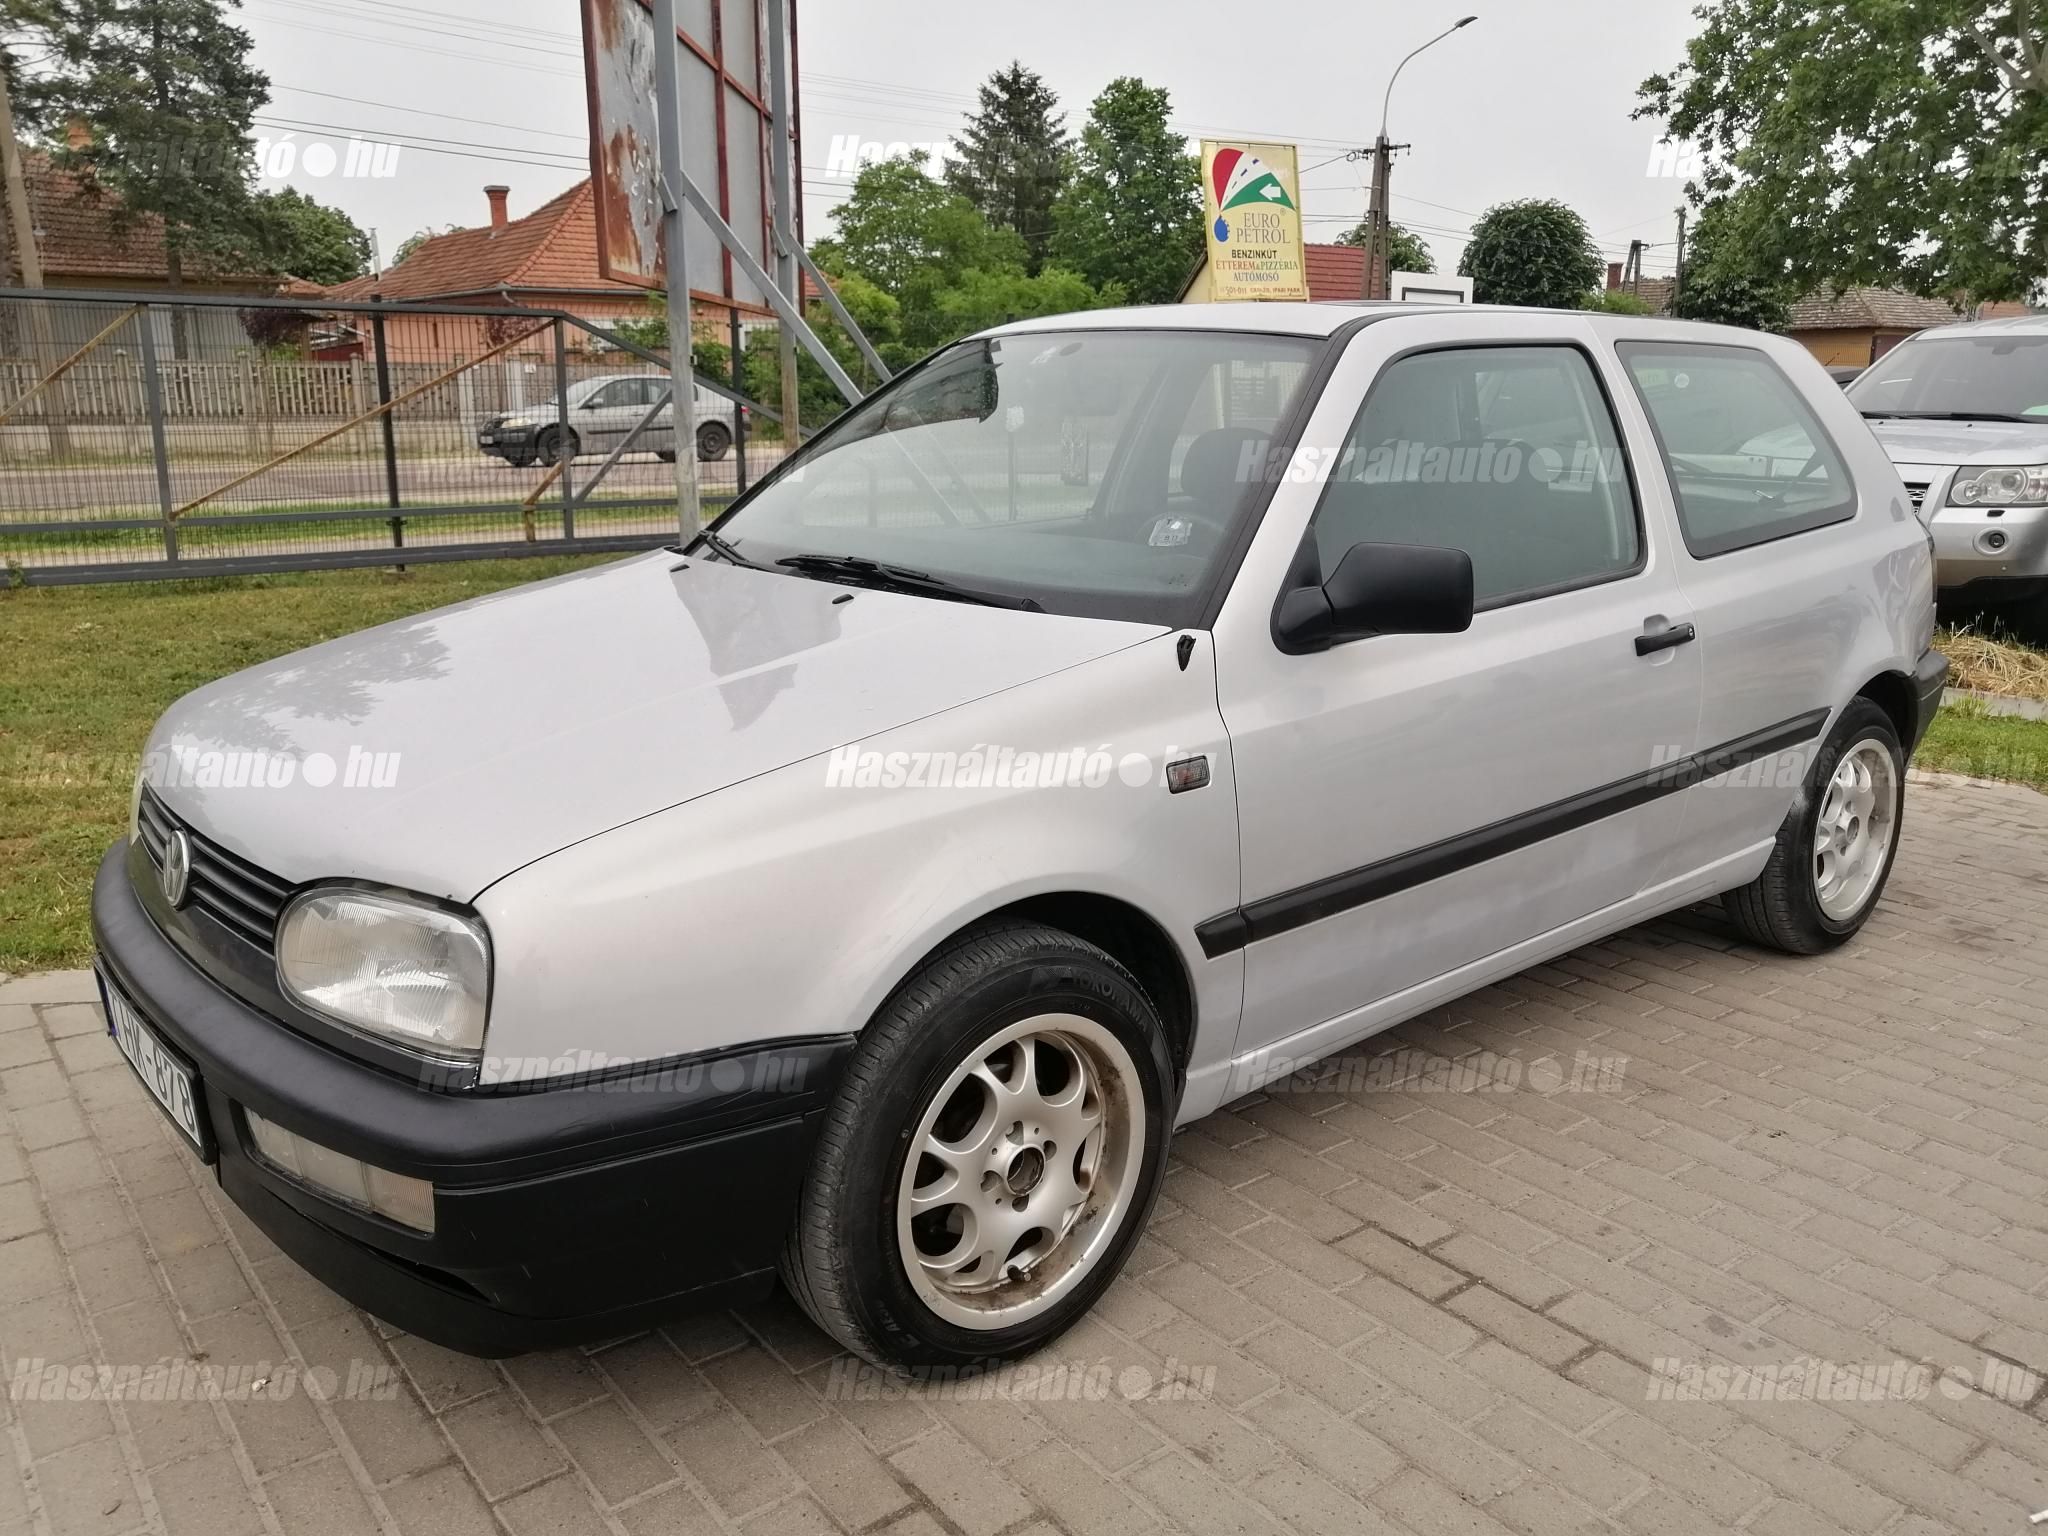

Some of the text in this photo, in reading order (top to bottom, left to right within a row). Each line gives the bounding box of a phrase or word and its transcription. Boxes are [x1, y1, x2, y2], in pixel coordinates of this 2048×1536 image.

[1244, 212, 1280, 228] EURO
[1236, 228, 1291, 244] PETROL
[1232, 248, 1277, 259] BENZINKÚT
